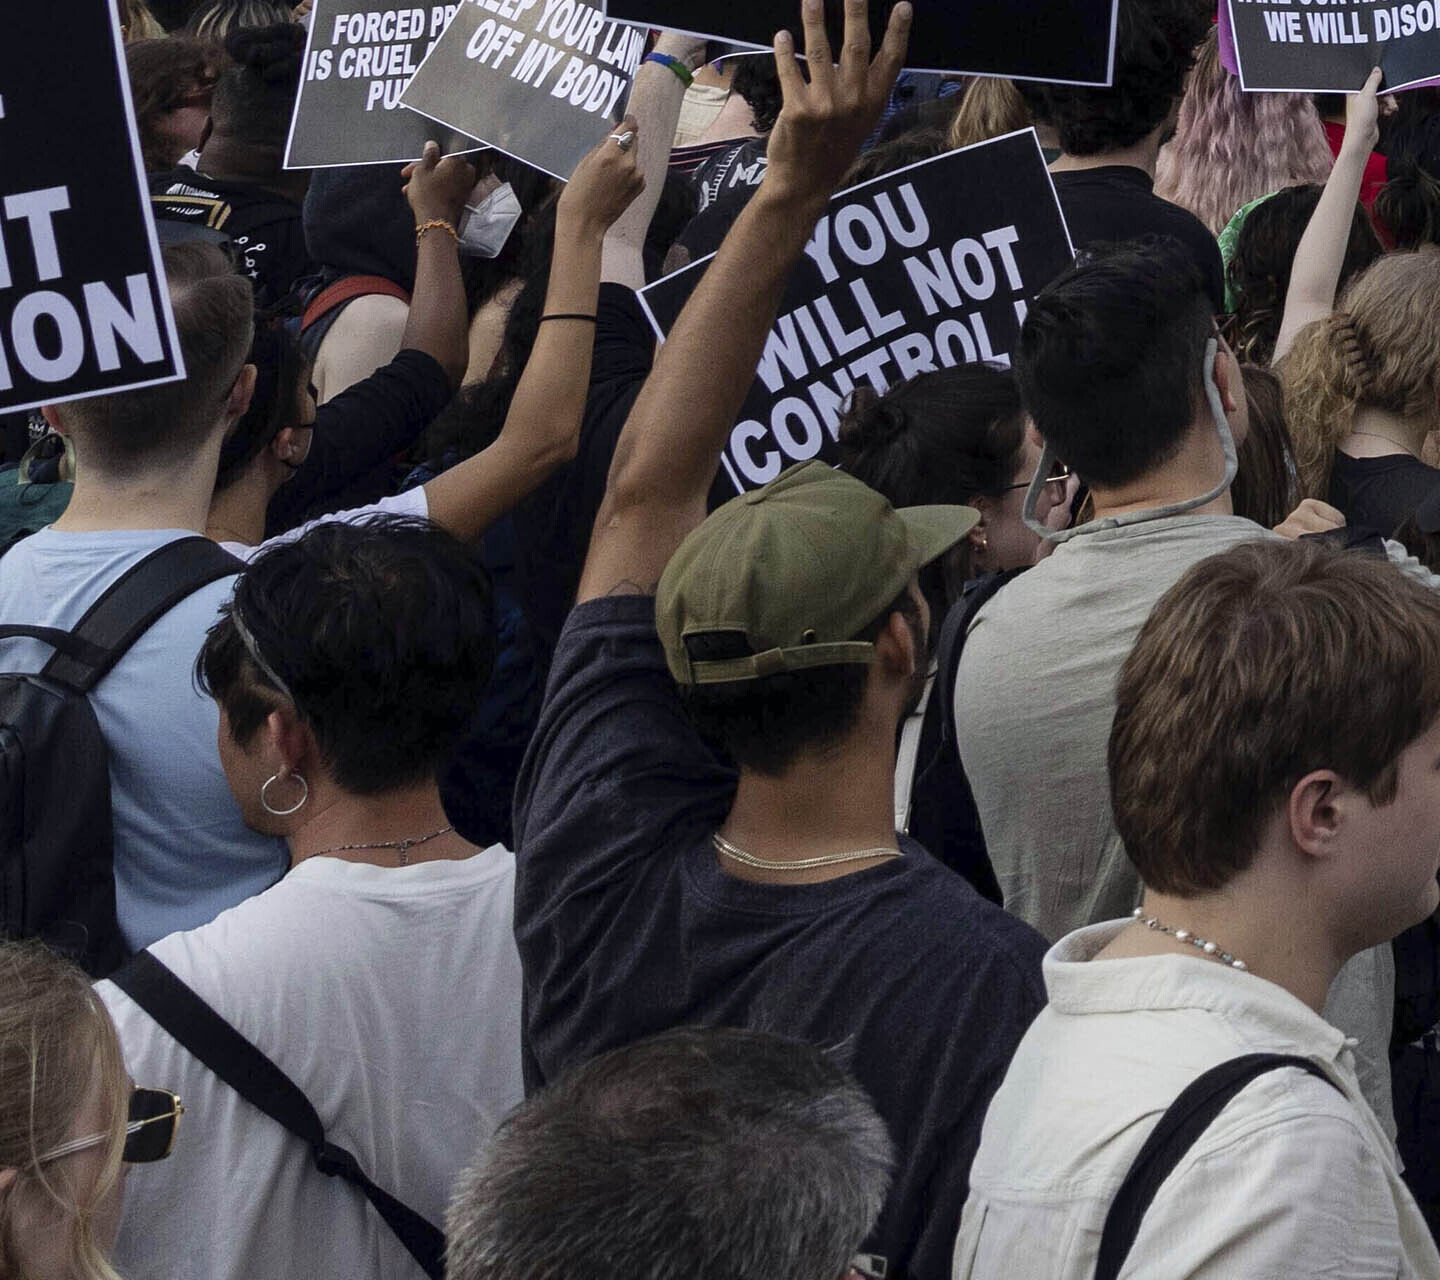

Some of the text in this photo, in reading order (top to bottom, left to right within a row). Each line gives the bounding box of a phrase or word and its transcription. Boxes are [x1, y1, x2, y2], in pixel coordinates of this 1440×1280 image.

[466, 19, 627, 119] OFF MY BODY
